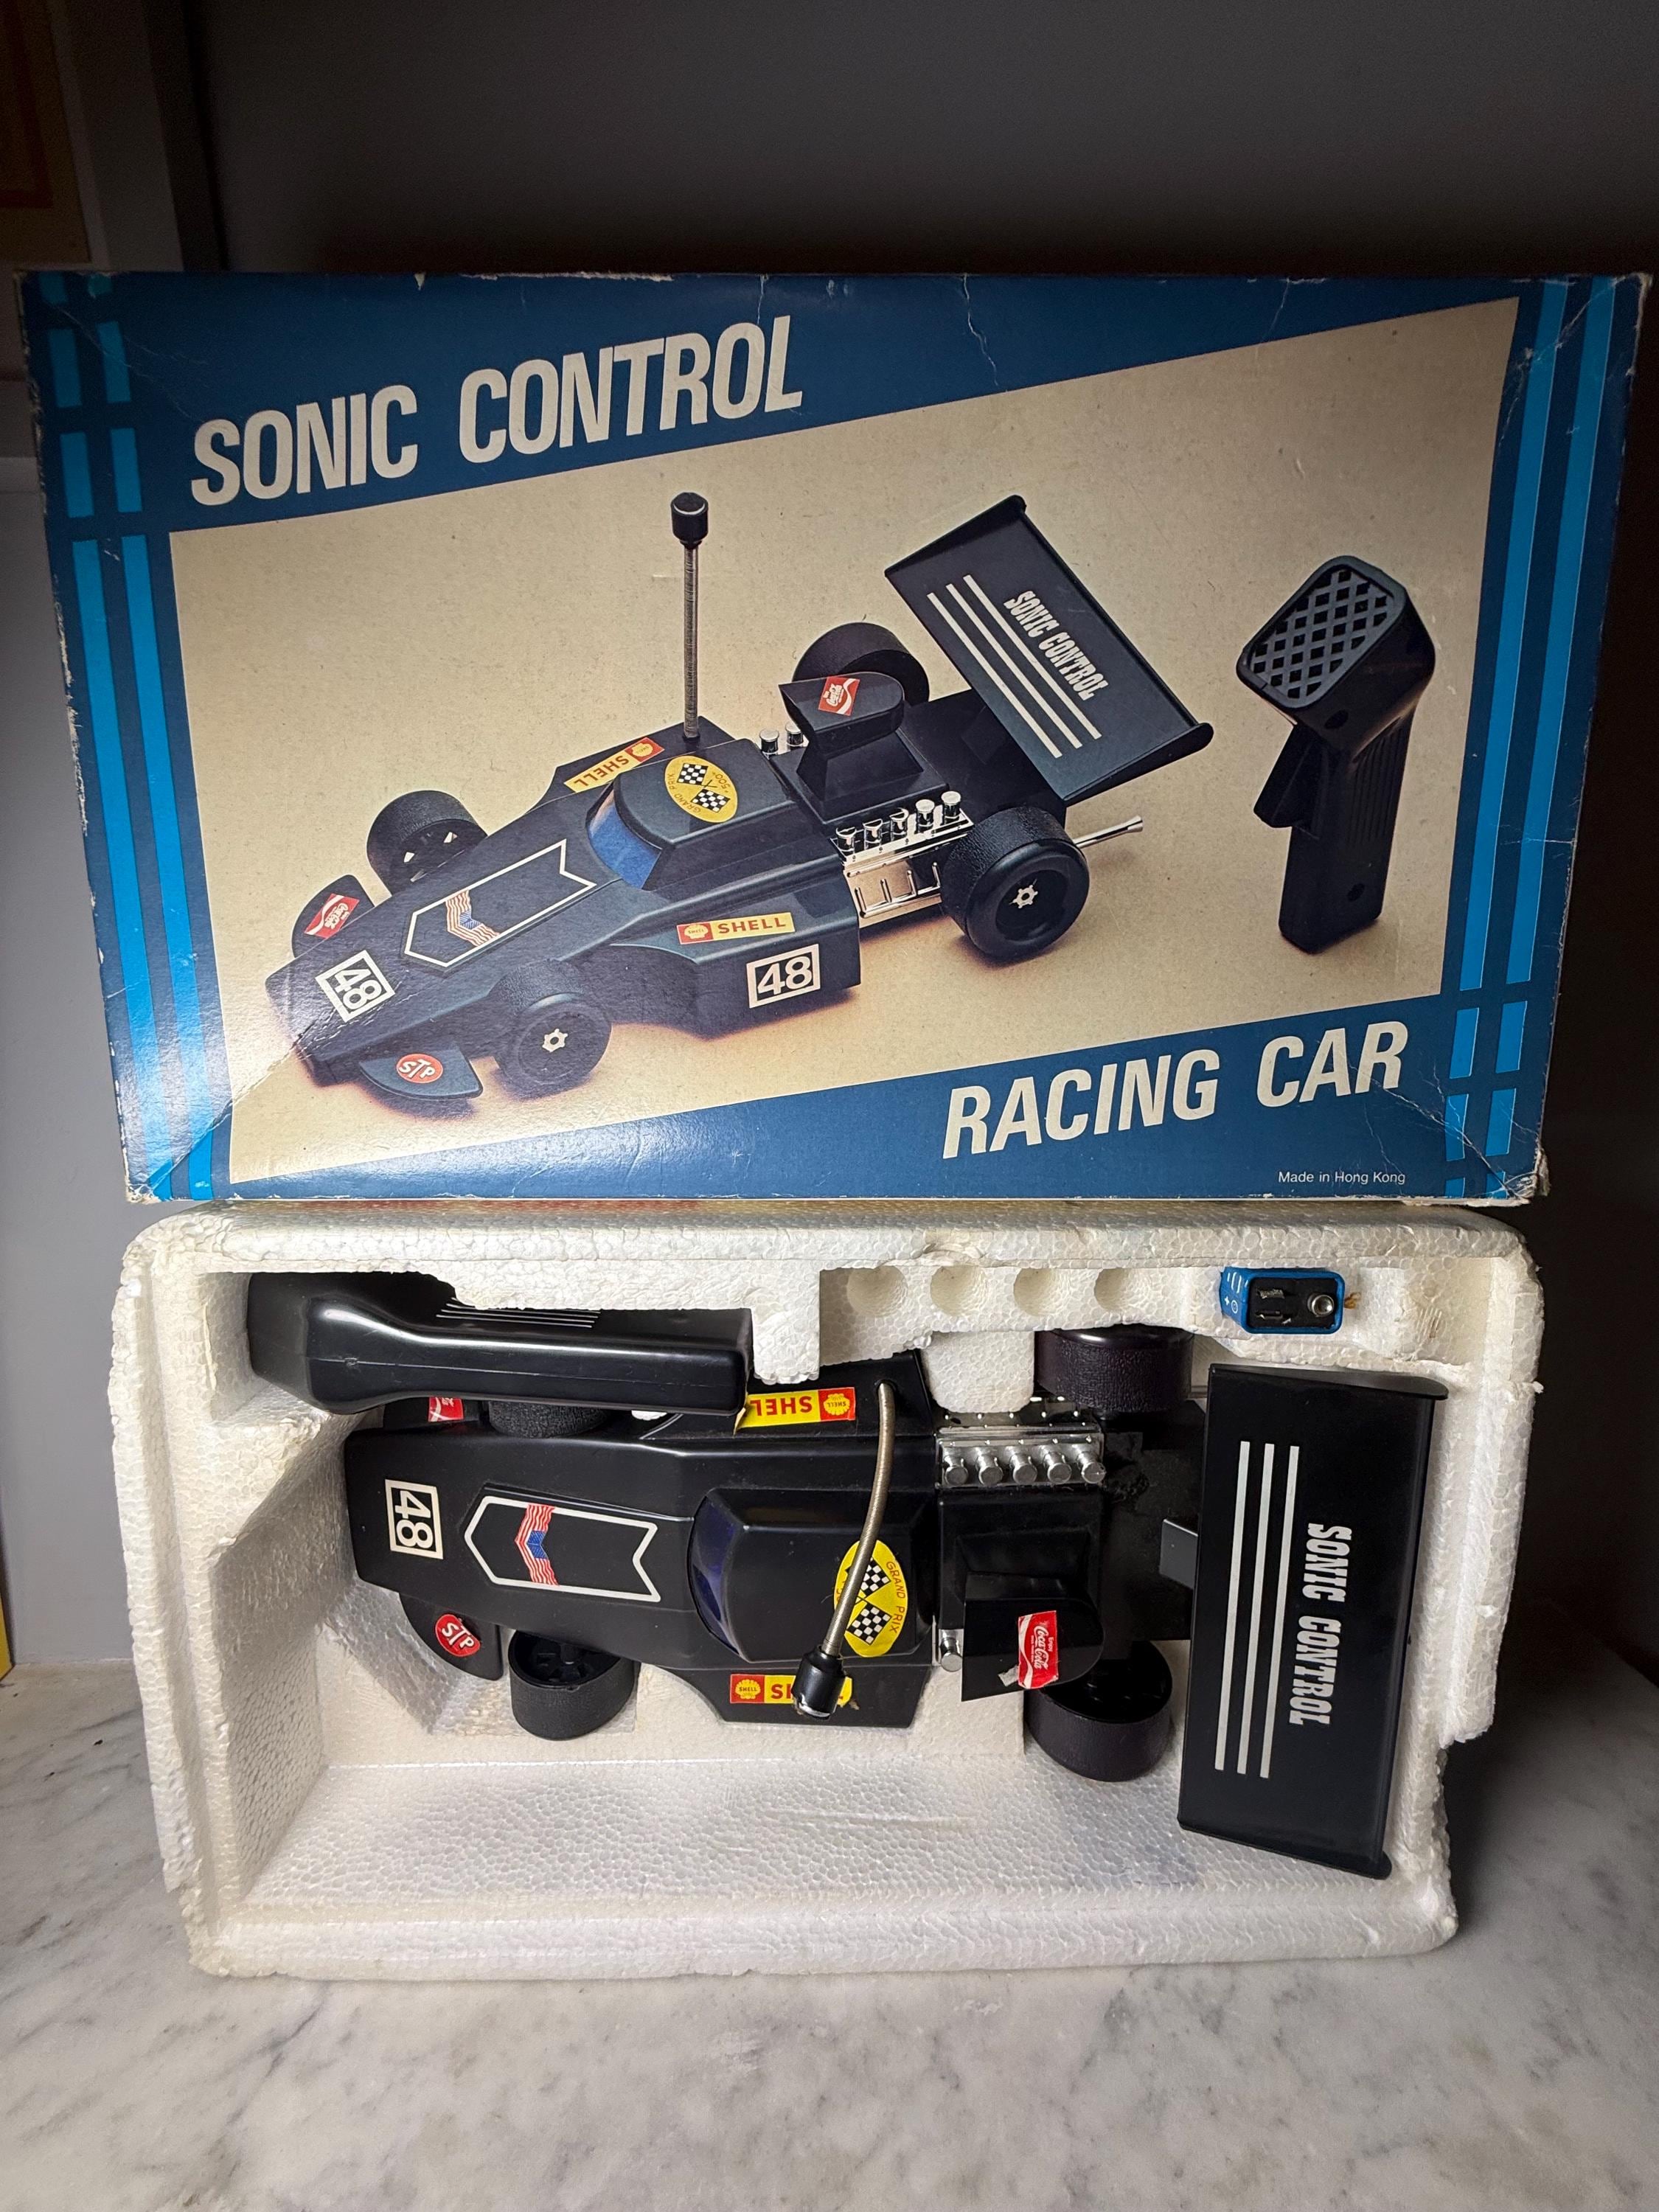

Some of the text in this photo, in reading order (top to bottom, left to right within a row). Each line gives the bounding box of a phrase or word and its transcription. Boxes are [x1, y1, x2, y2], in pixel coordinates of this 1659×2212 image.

[190, 316, 804, 507] SONIC CONTROL
[1004, 591, 1108, 700] SONIC CONTROL
[574, 755, 630, 787] SHELL
[667, 773, 701, 813] GRAND PRIX
[717, 917, 786, 934] SHELL
[334, 968, 382, 1009] 48
[757, 956, 813, 995] 48
[399, 1059, 435, 1078] STP
[942, 1021, 1408, 1159] RACING CAR
[1278, 1171, 1405, 1185] Made in Hong Kong
[750, 1396, 813, 1416] SHEL
[394, 1490, 434, 1548] 48
[886, 1561, 905, 1634] GRAND PRIX
[442, 1623, 474, 1648] STP
[1289, 1523, 1352, 1725] SONIC CONTROL
[1034, 1626, 1049, 1670] Coca-Cola
